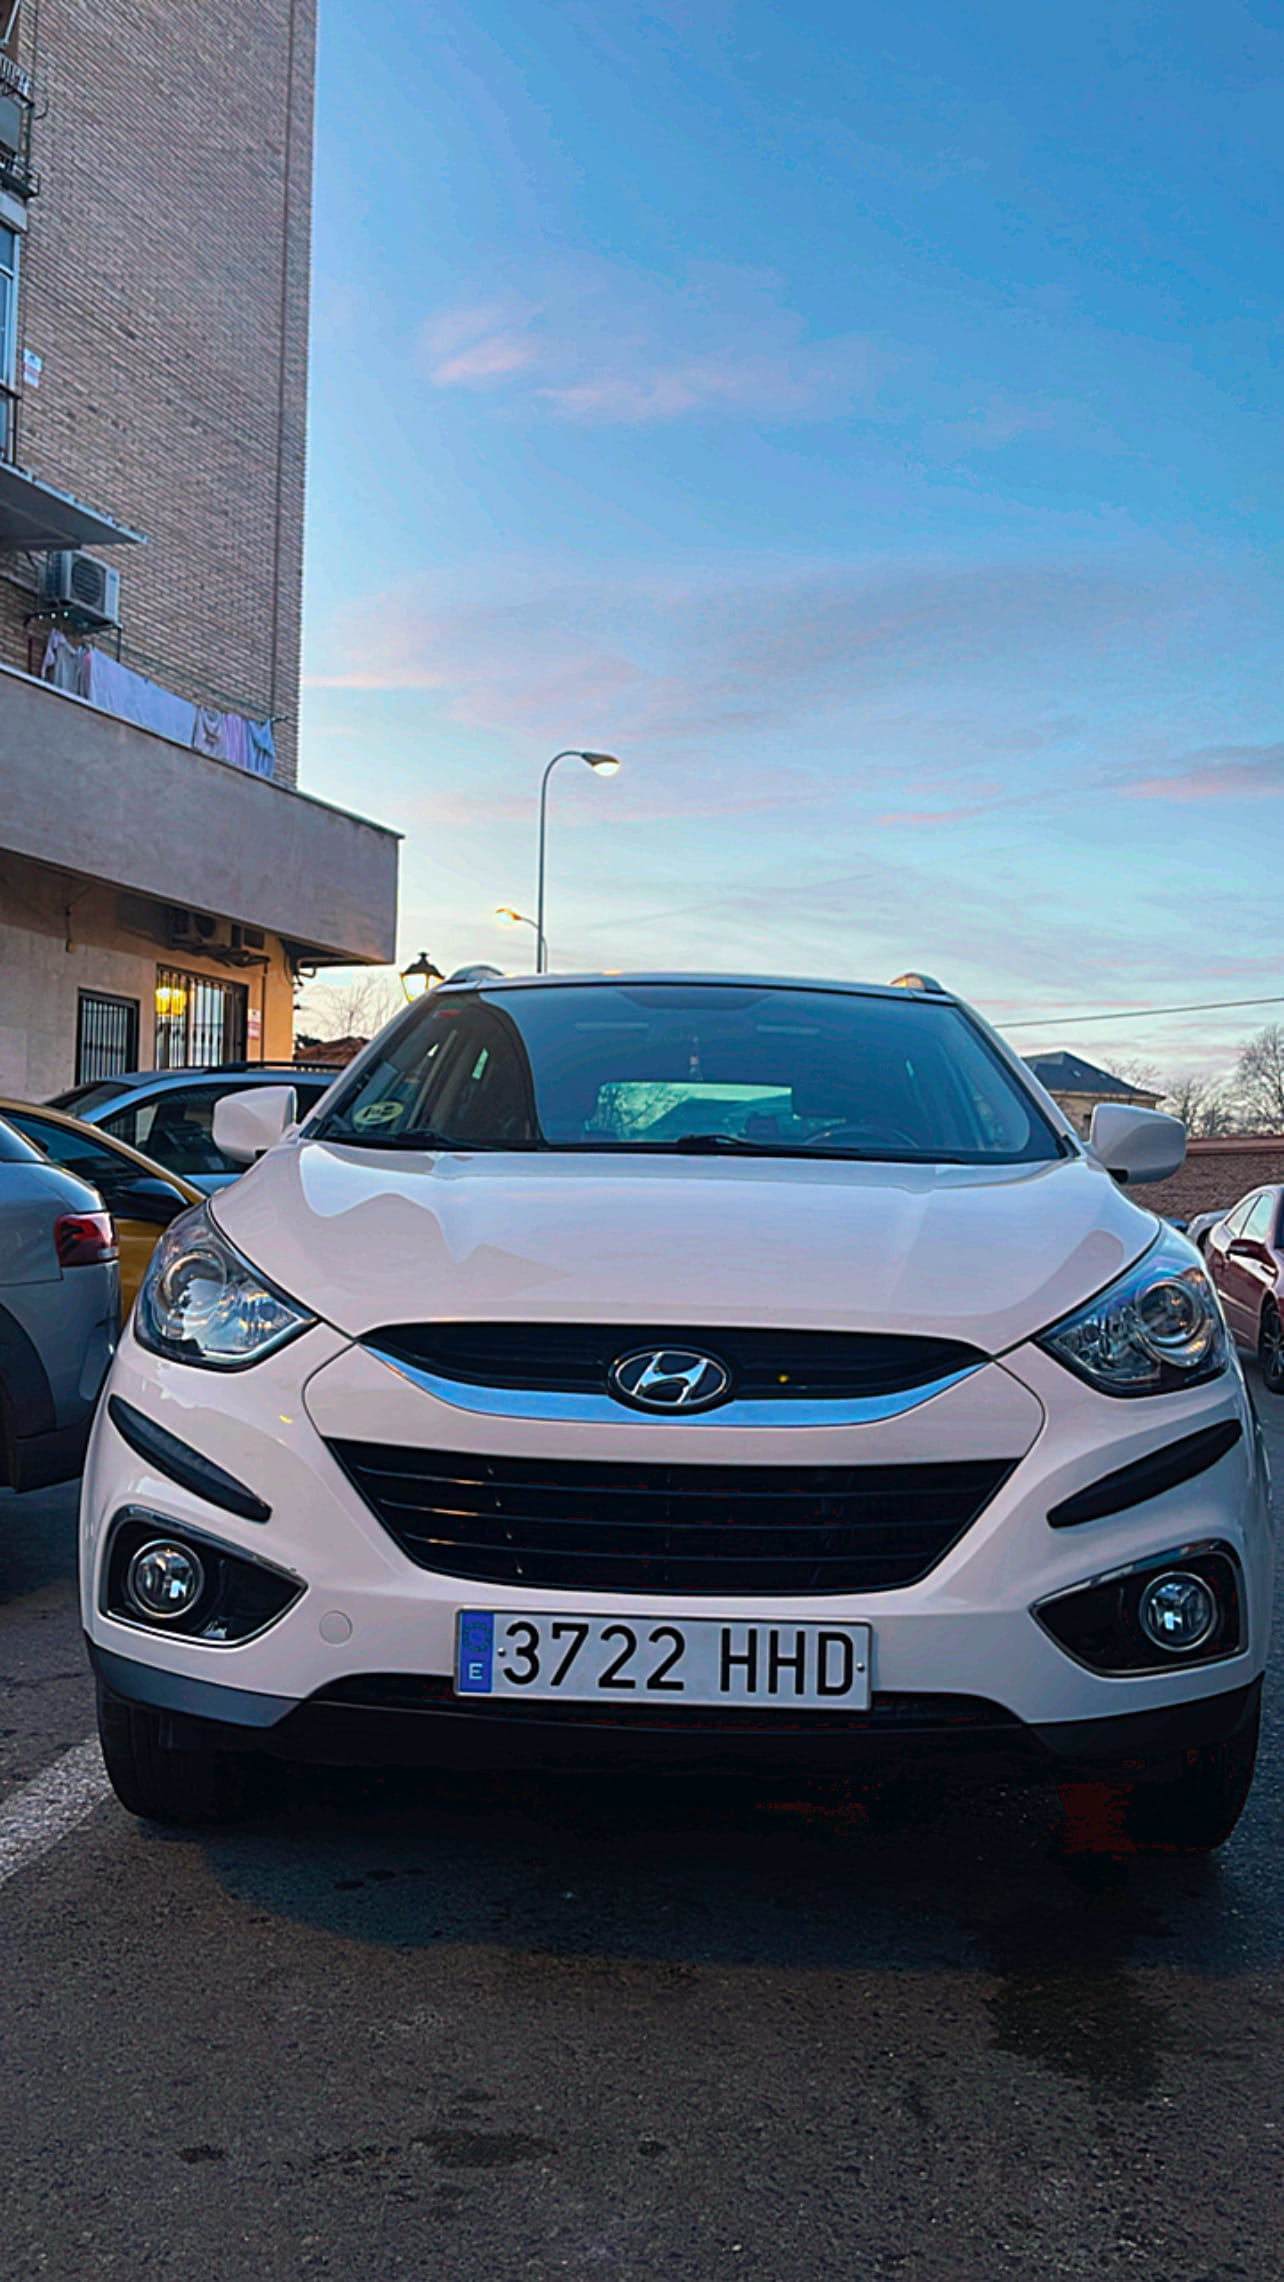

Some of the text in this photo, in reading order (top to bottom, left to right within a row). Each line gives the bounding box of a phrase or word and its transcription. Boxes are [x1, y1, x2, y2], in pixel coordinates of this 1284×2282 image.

[468, 1662, 484, 1680] E
[502, 1620, 855, 1698] 3722 HHD
